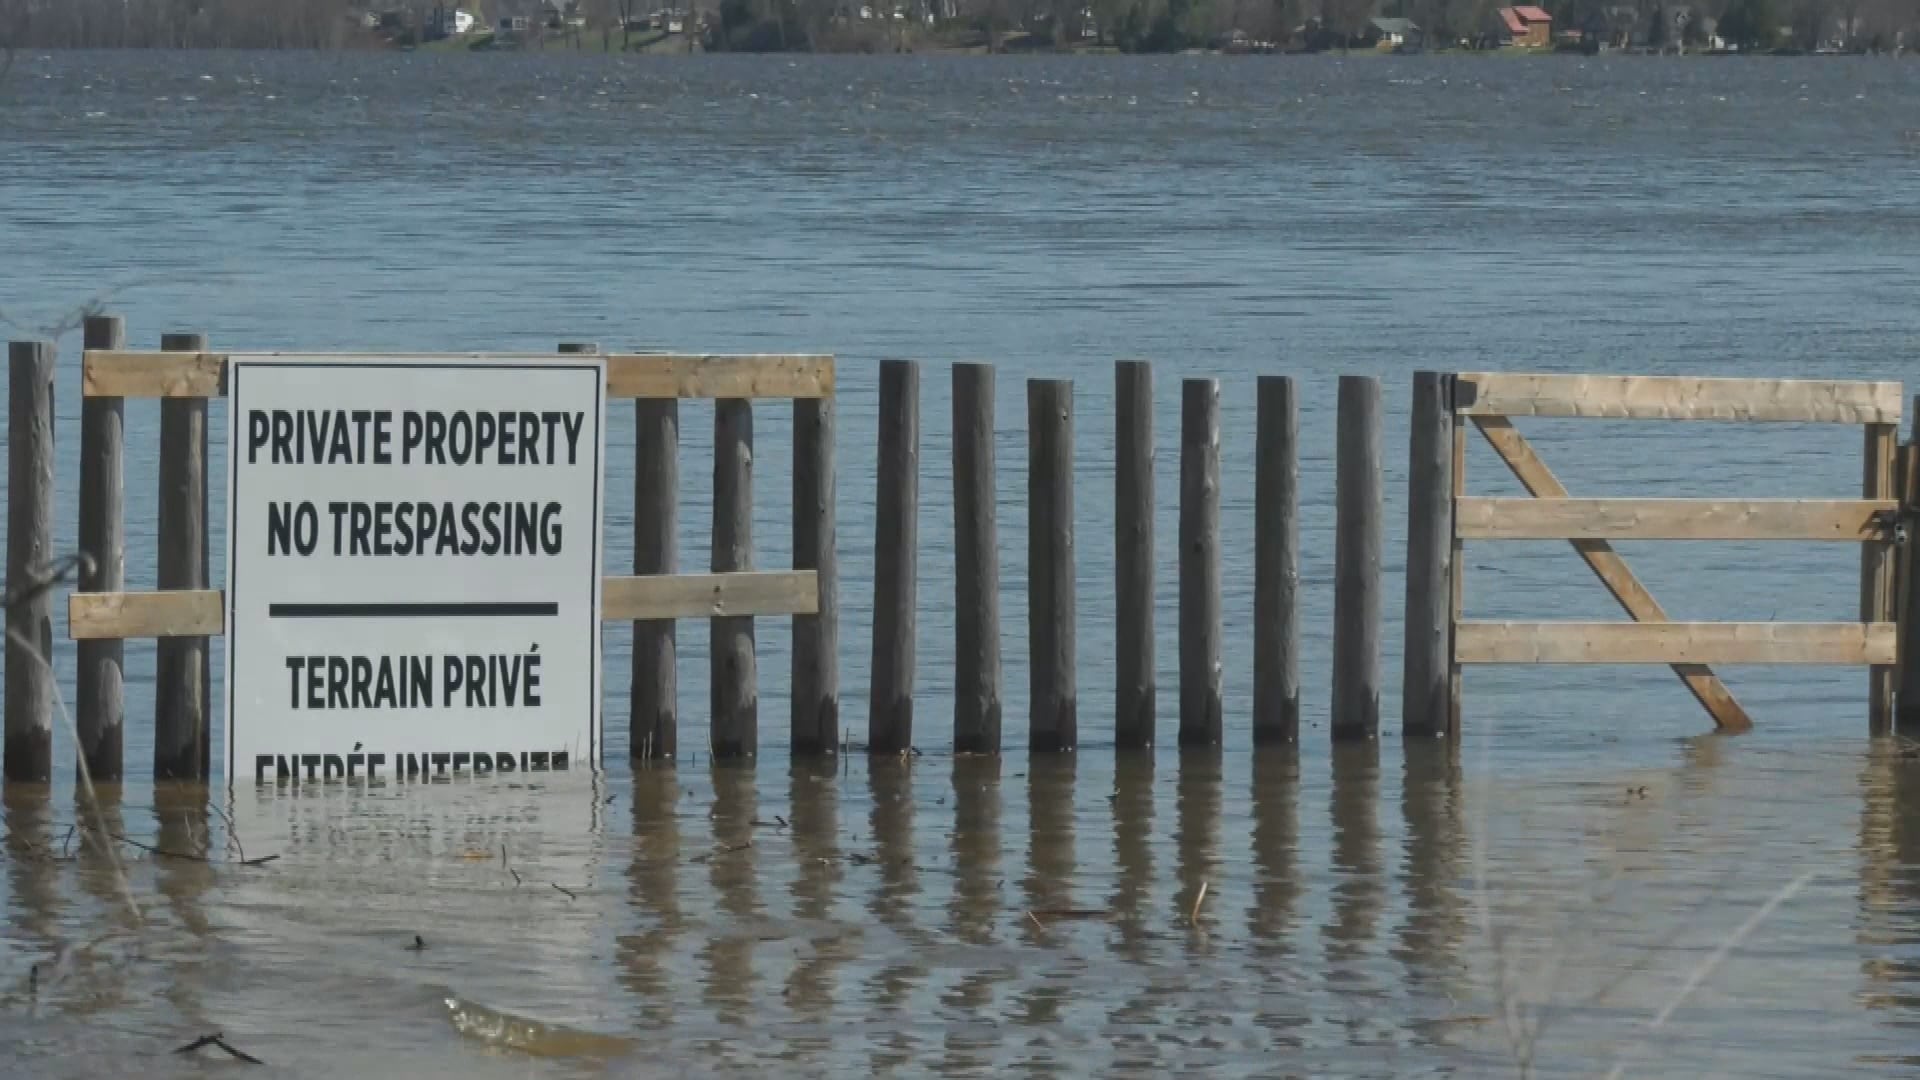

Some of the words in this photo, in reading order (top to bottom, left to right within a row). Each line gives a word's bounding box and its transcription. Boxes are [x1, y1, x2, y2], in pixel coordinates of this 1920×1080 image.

[248, 409, 393, 465] PRIVATE
[402, 411, 585, 466] PROPERTY
[267, 501, 319, 556] NO
[328, 501, 563, 556] TRESPASSING
[285, 655, 433, 709] TERRAIN
[443, 643, 541, 707] PRIVÉ
